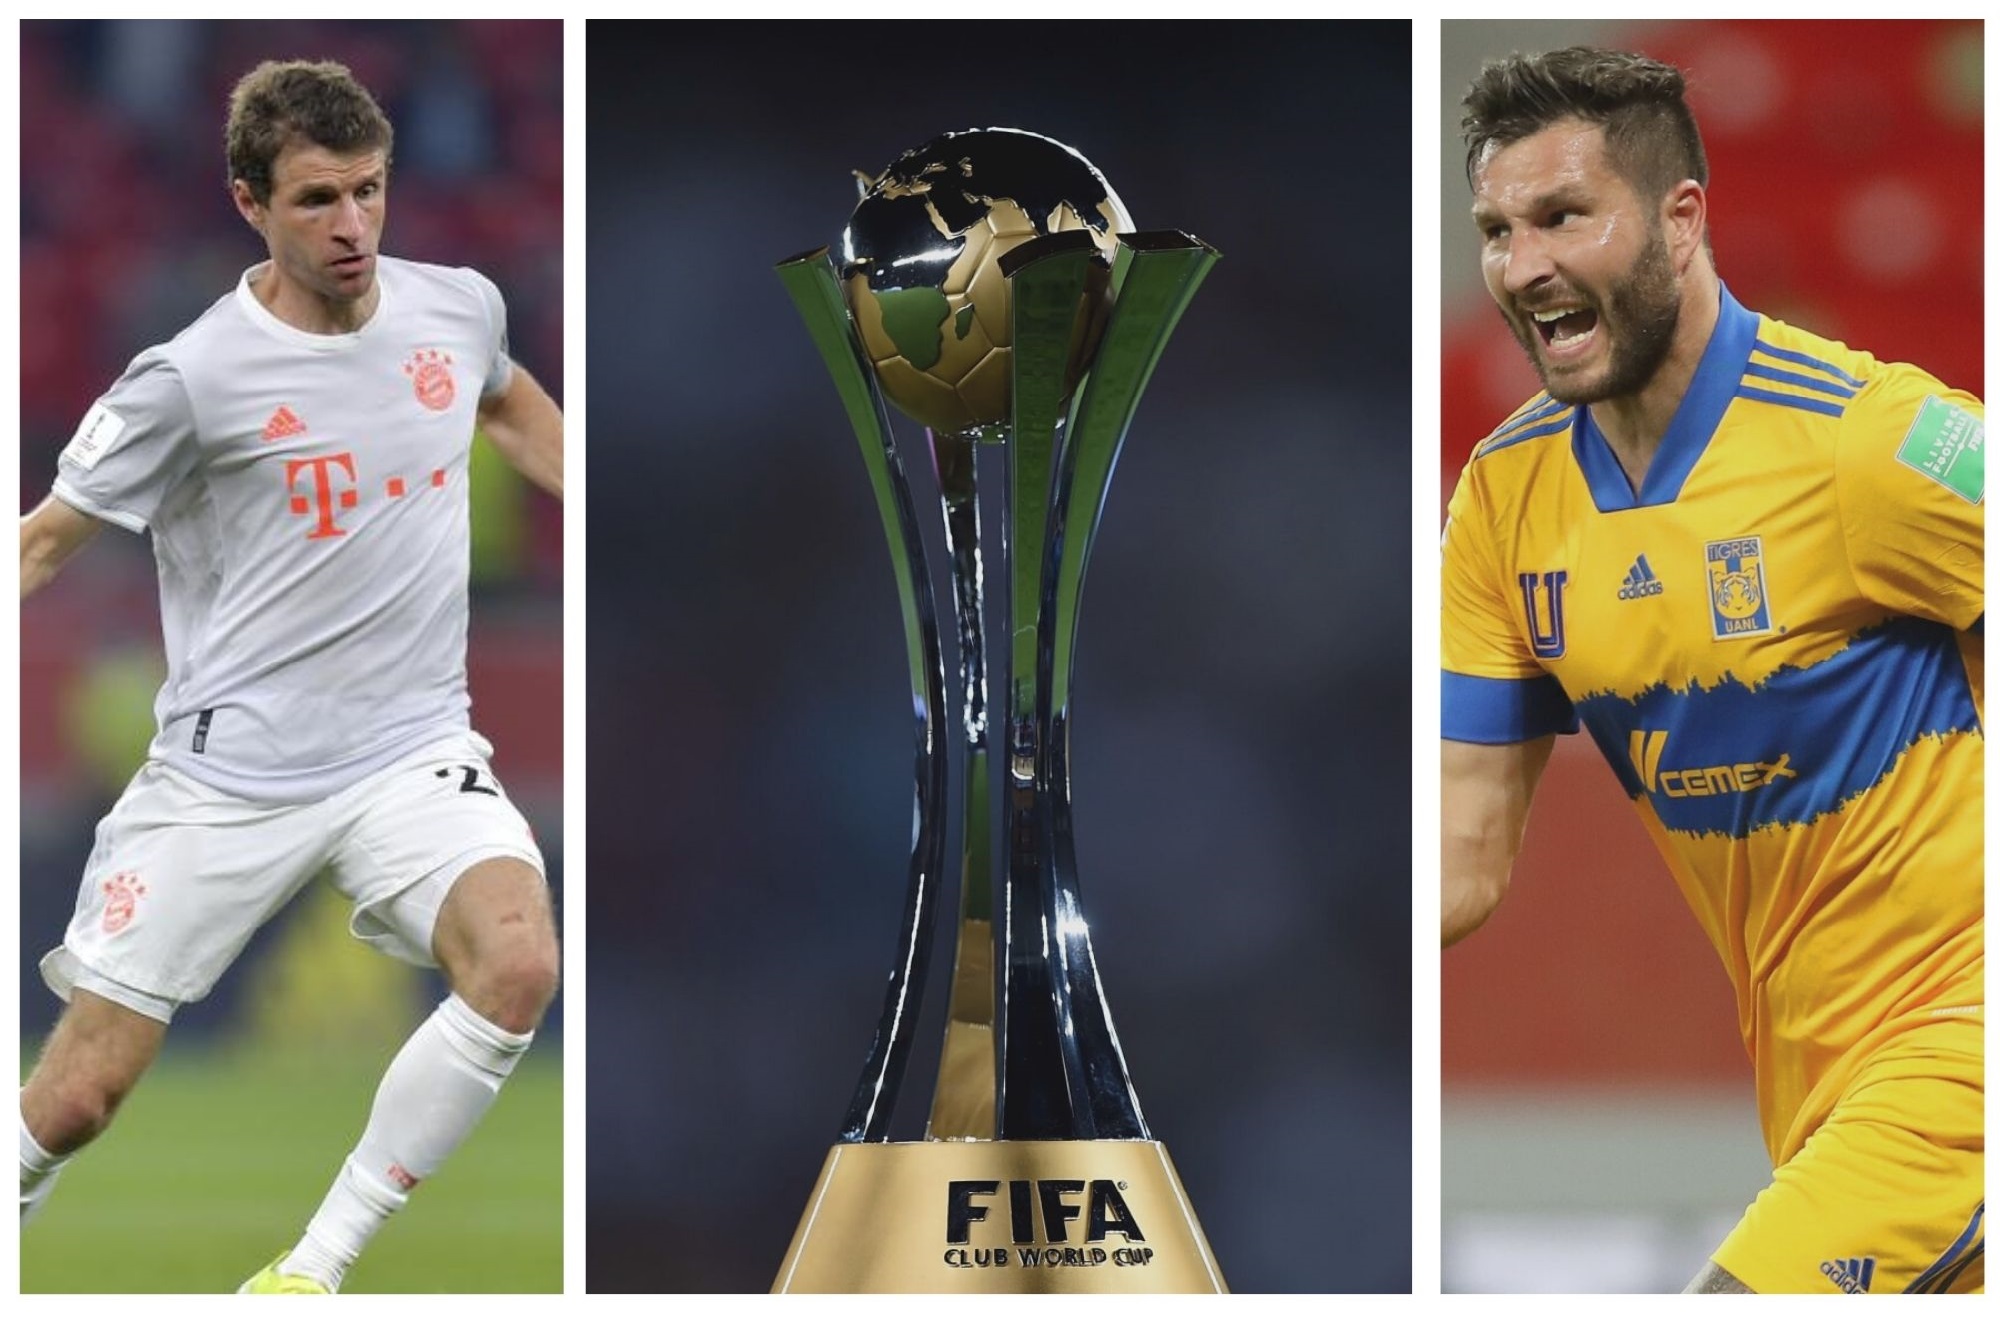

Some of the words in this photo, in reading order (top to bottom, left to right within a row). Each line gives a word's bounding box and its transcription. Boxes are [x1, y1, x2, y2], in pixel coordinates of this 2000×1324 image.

[1923, 406, 1960, 469] LIVING
[1931, 416, 1968, 474] FOOTBALL
[1708, 540, 1758, 561] TIGRES
[1617, 582, 1664, 601] adidas
[1518, 570, 1568, 661] U
[1725, 618, 1759, 634] UANL
[1660, 753, 1797, 798] CEMEX
[946, 1180, 1146, 1245] FIFA
[944, 1249, 1008, 1268] CLUB
[1018, 1248, 1107, 1268] WORLD
[1112, 1248, 1154, 1267] CUP
